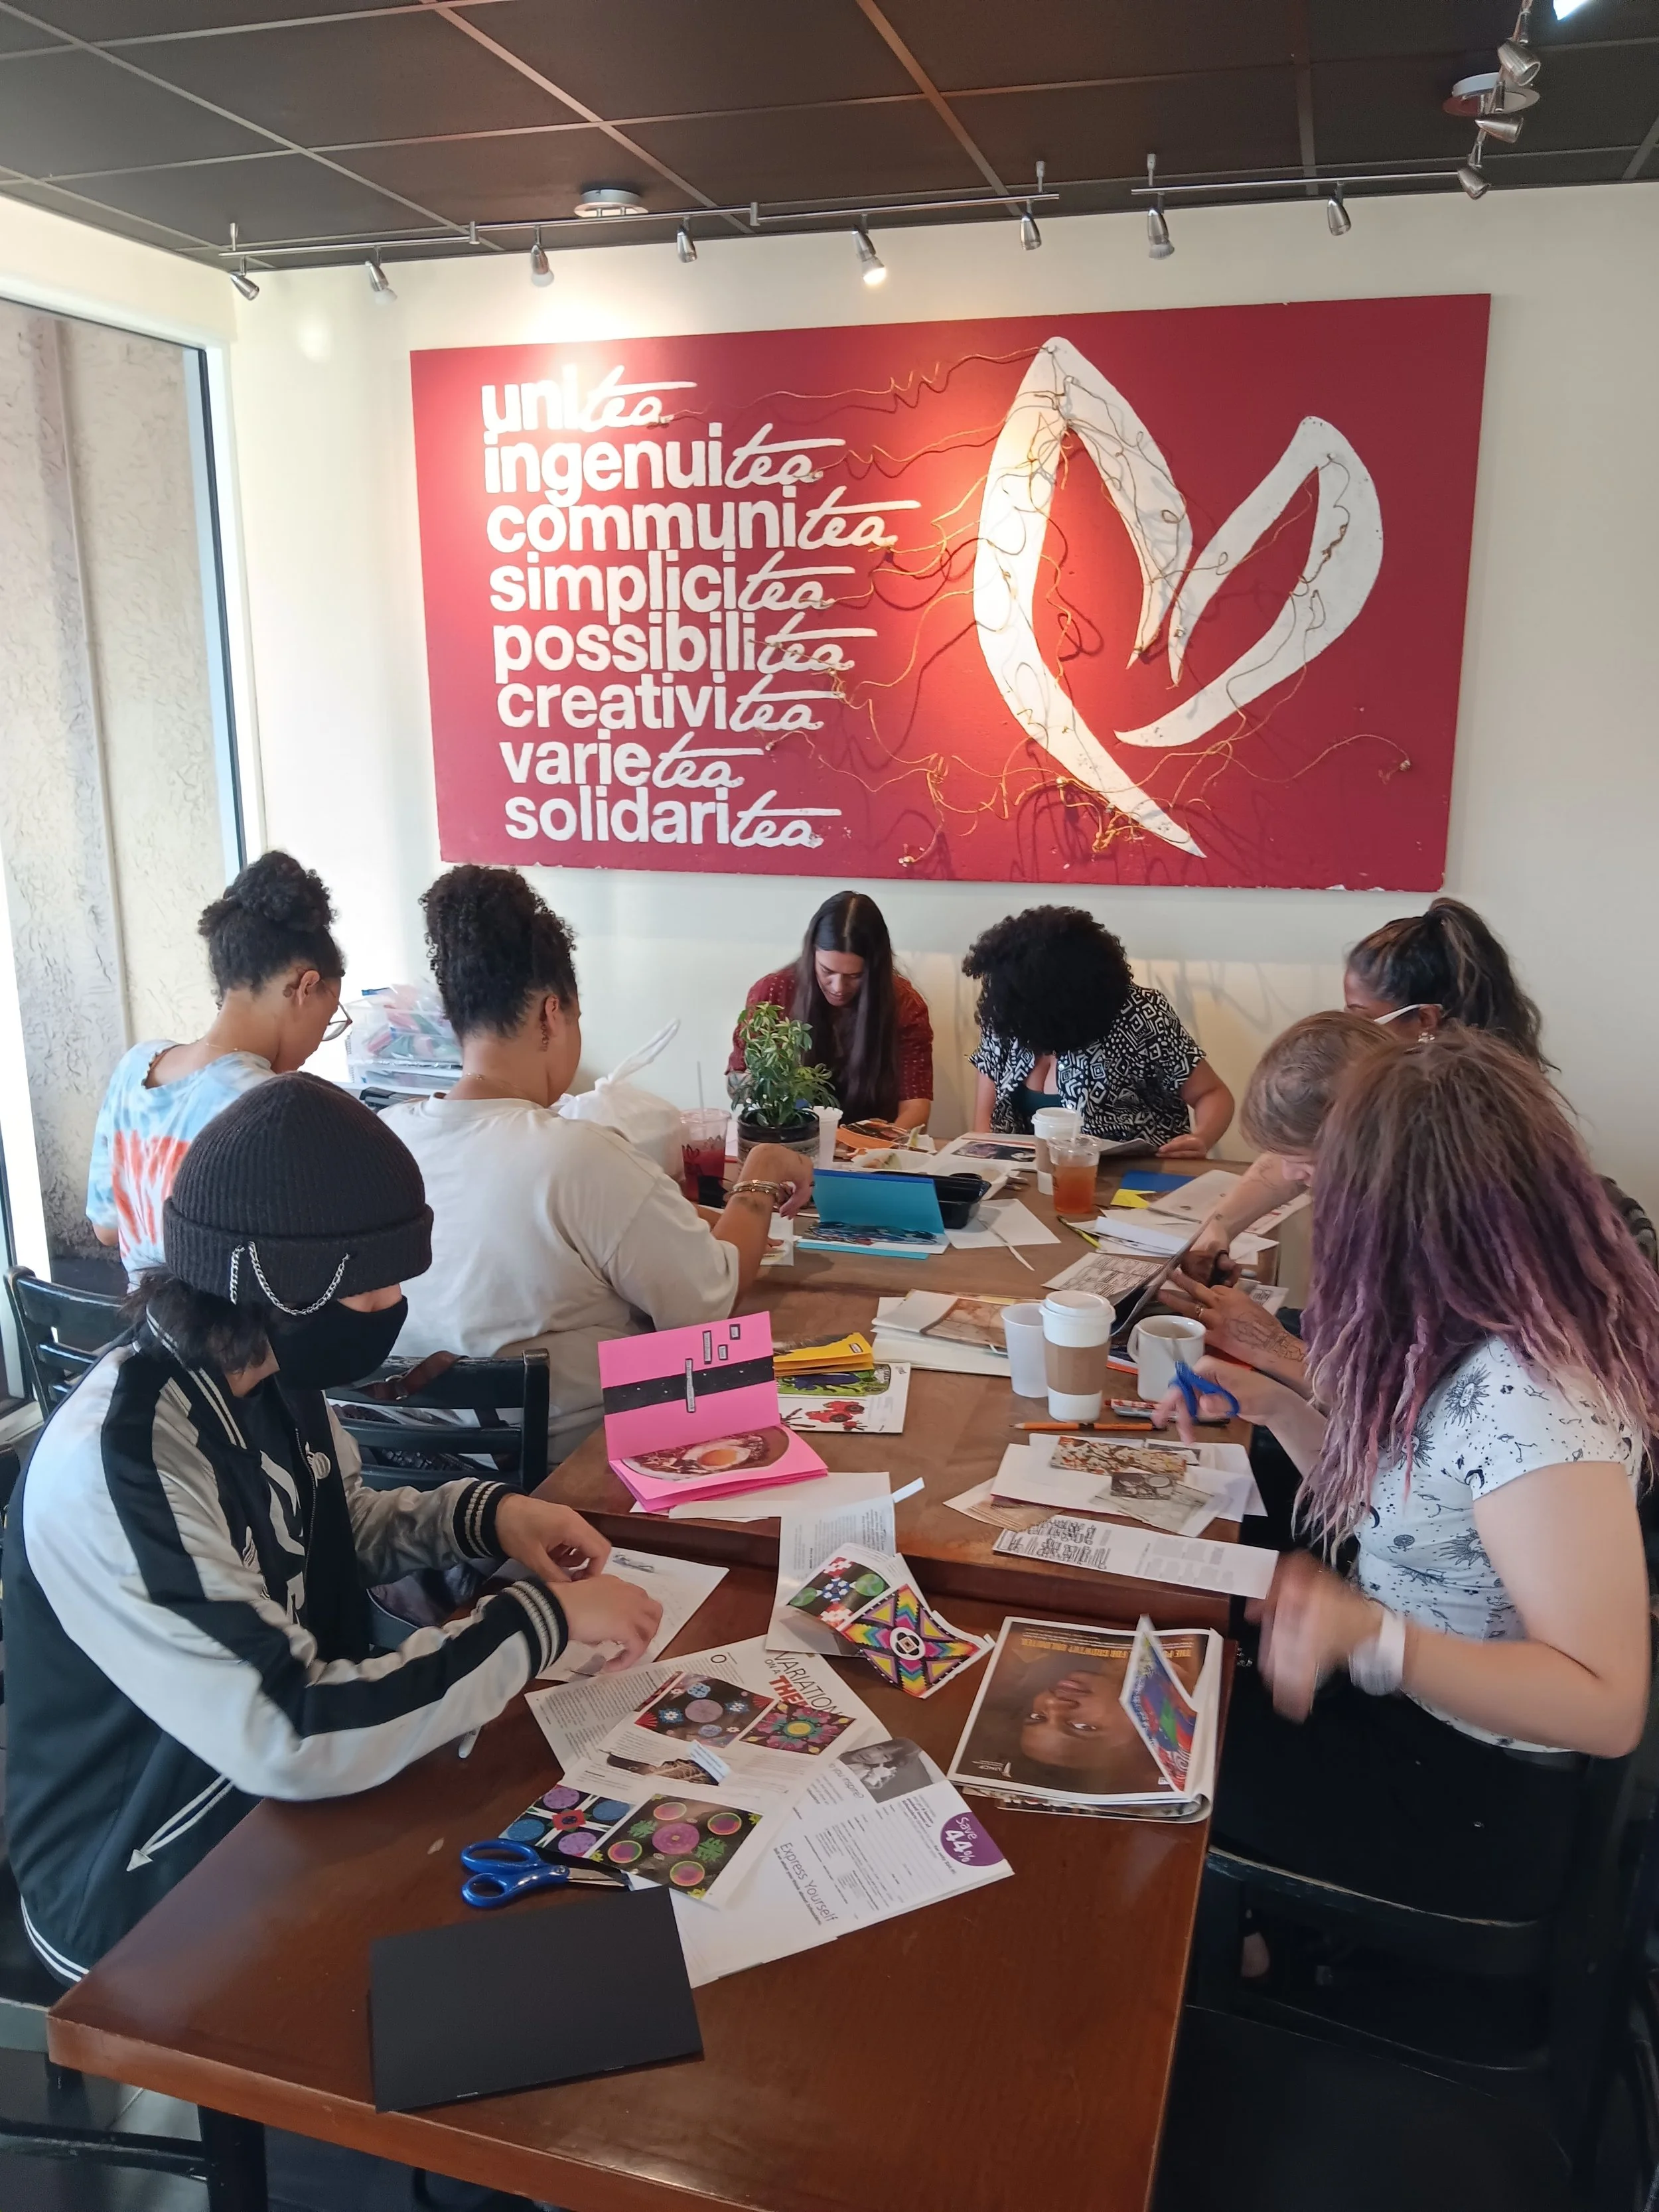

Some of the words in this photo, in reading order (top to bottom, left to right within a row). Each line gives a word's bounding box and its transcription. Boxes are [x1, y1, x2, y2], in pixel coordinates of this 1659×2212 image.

[482, 365, 697, 433] unitea
[483, 423, 845, 507] ingenuitea
[486, 484, 921, 552] communitea
[489, 550, 855, 625] simplicitea
[493, 611, 877, 683] possibilitea
[496, 671, 845, 731] creativitea
[500, 729, 764, 789] varietea
[505, 786, 841, 848] solidaritea
[945, 1830, 975, 1862] 44%
[956, 1816, 977, 1840] Save
[780, 1842, 808, 1880] Express
[805, 1880, 838, 1921] Yourself
